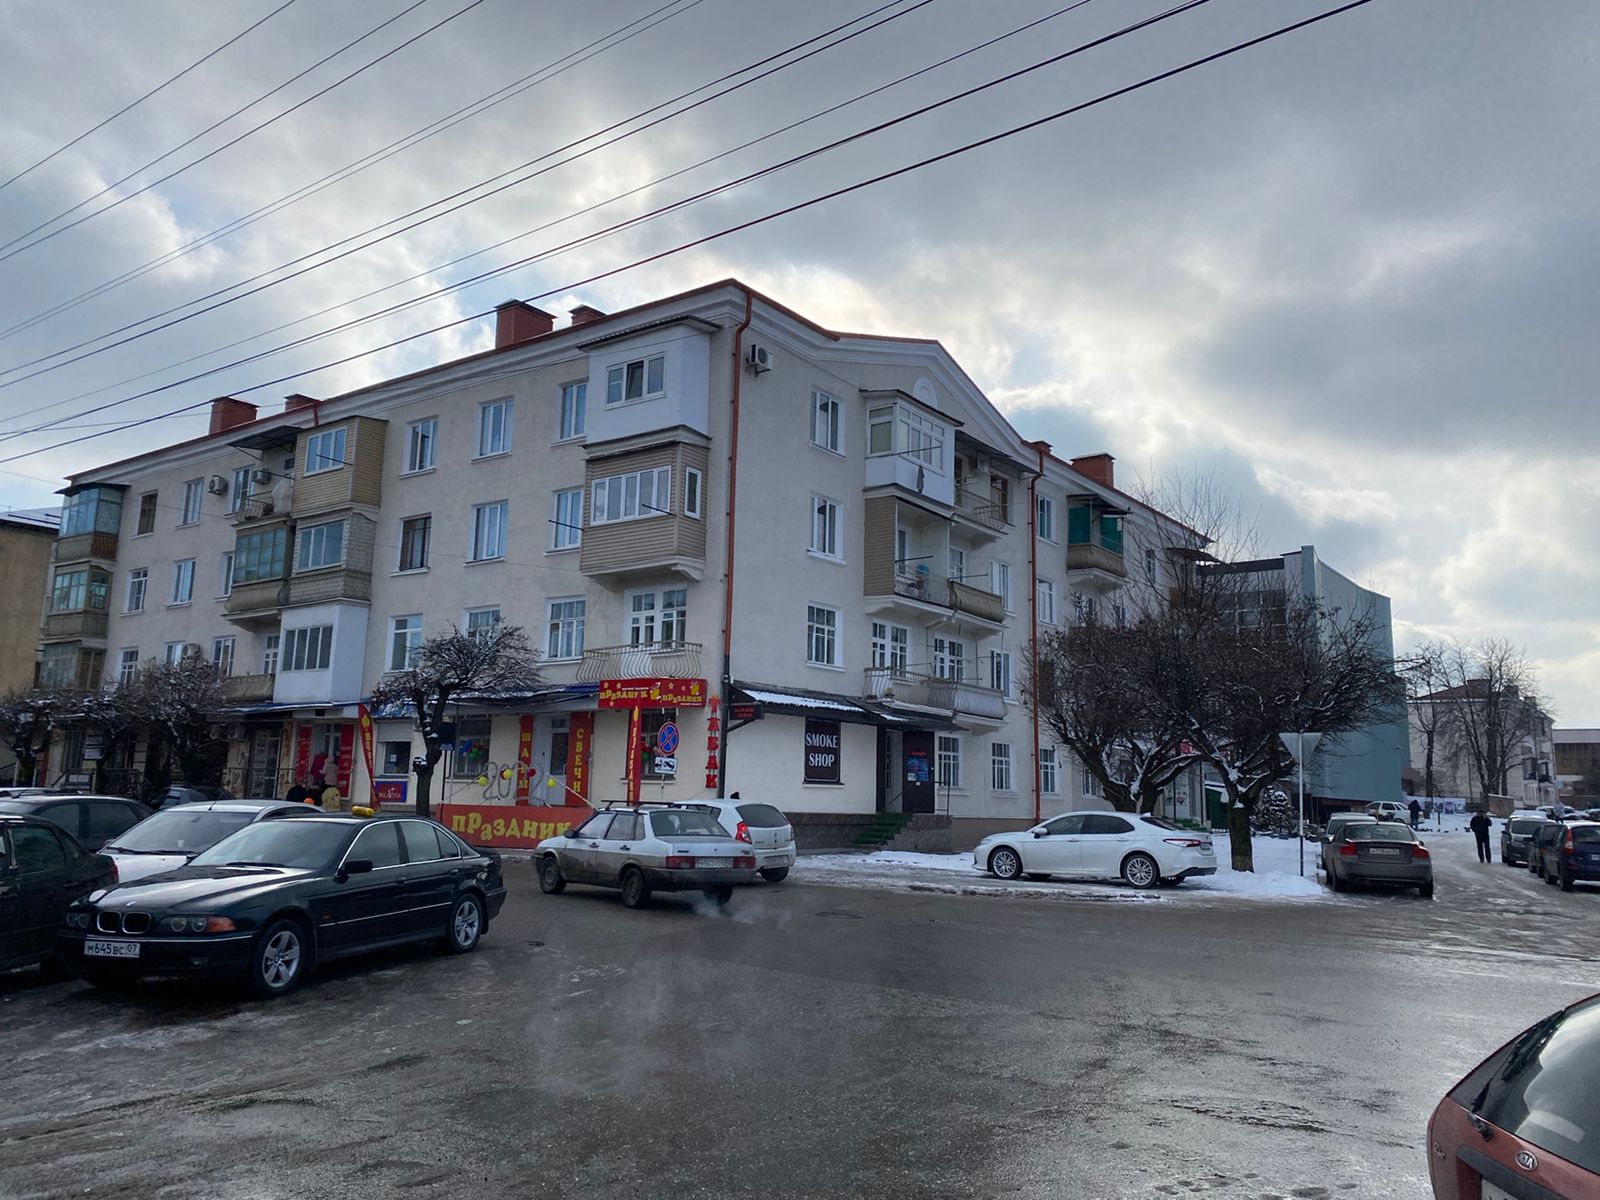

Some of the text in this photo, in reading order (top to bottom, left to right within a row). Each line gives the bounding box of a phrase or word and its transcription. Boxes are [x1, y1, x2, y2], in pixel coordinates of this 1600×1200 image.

[573, 728, 584, 793] СВЕЧИ
[705, 695, 720, 789] ТАБАК
[805, 732, 839, 749] SMOKE
[808, 752, 835, 767] SHOP
